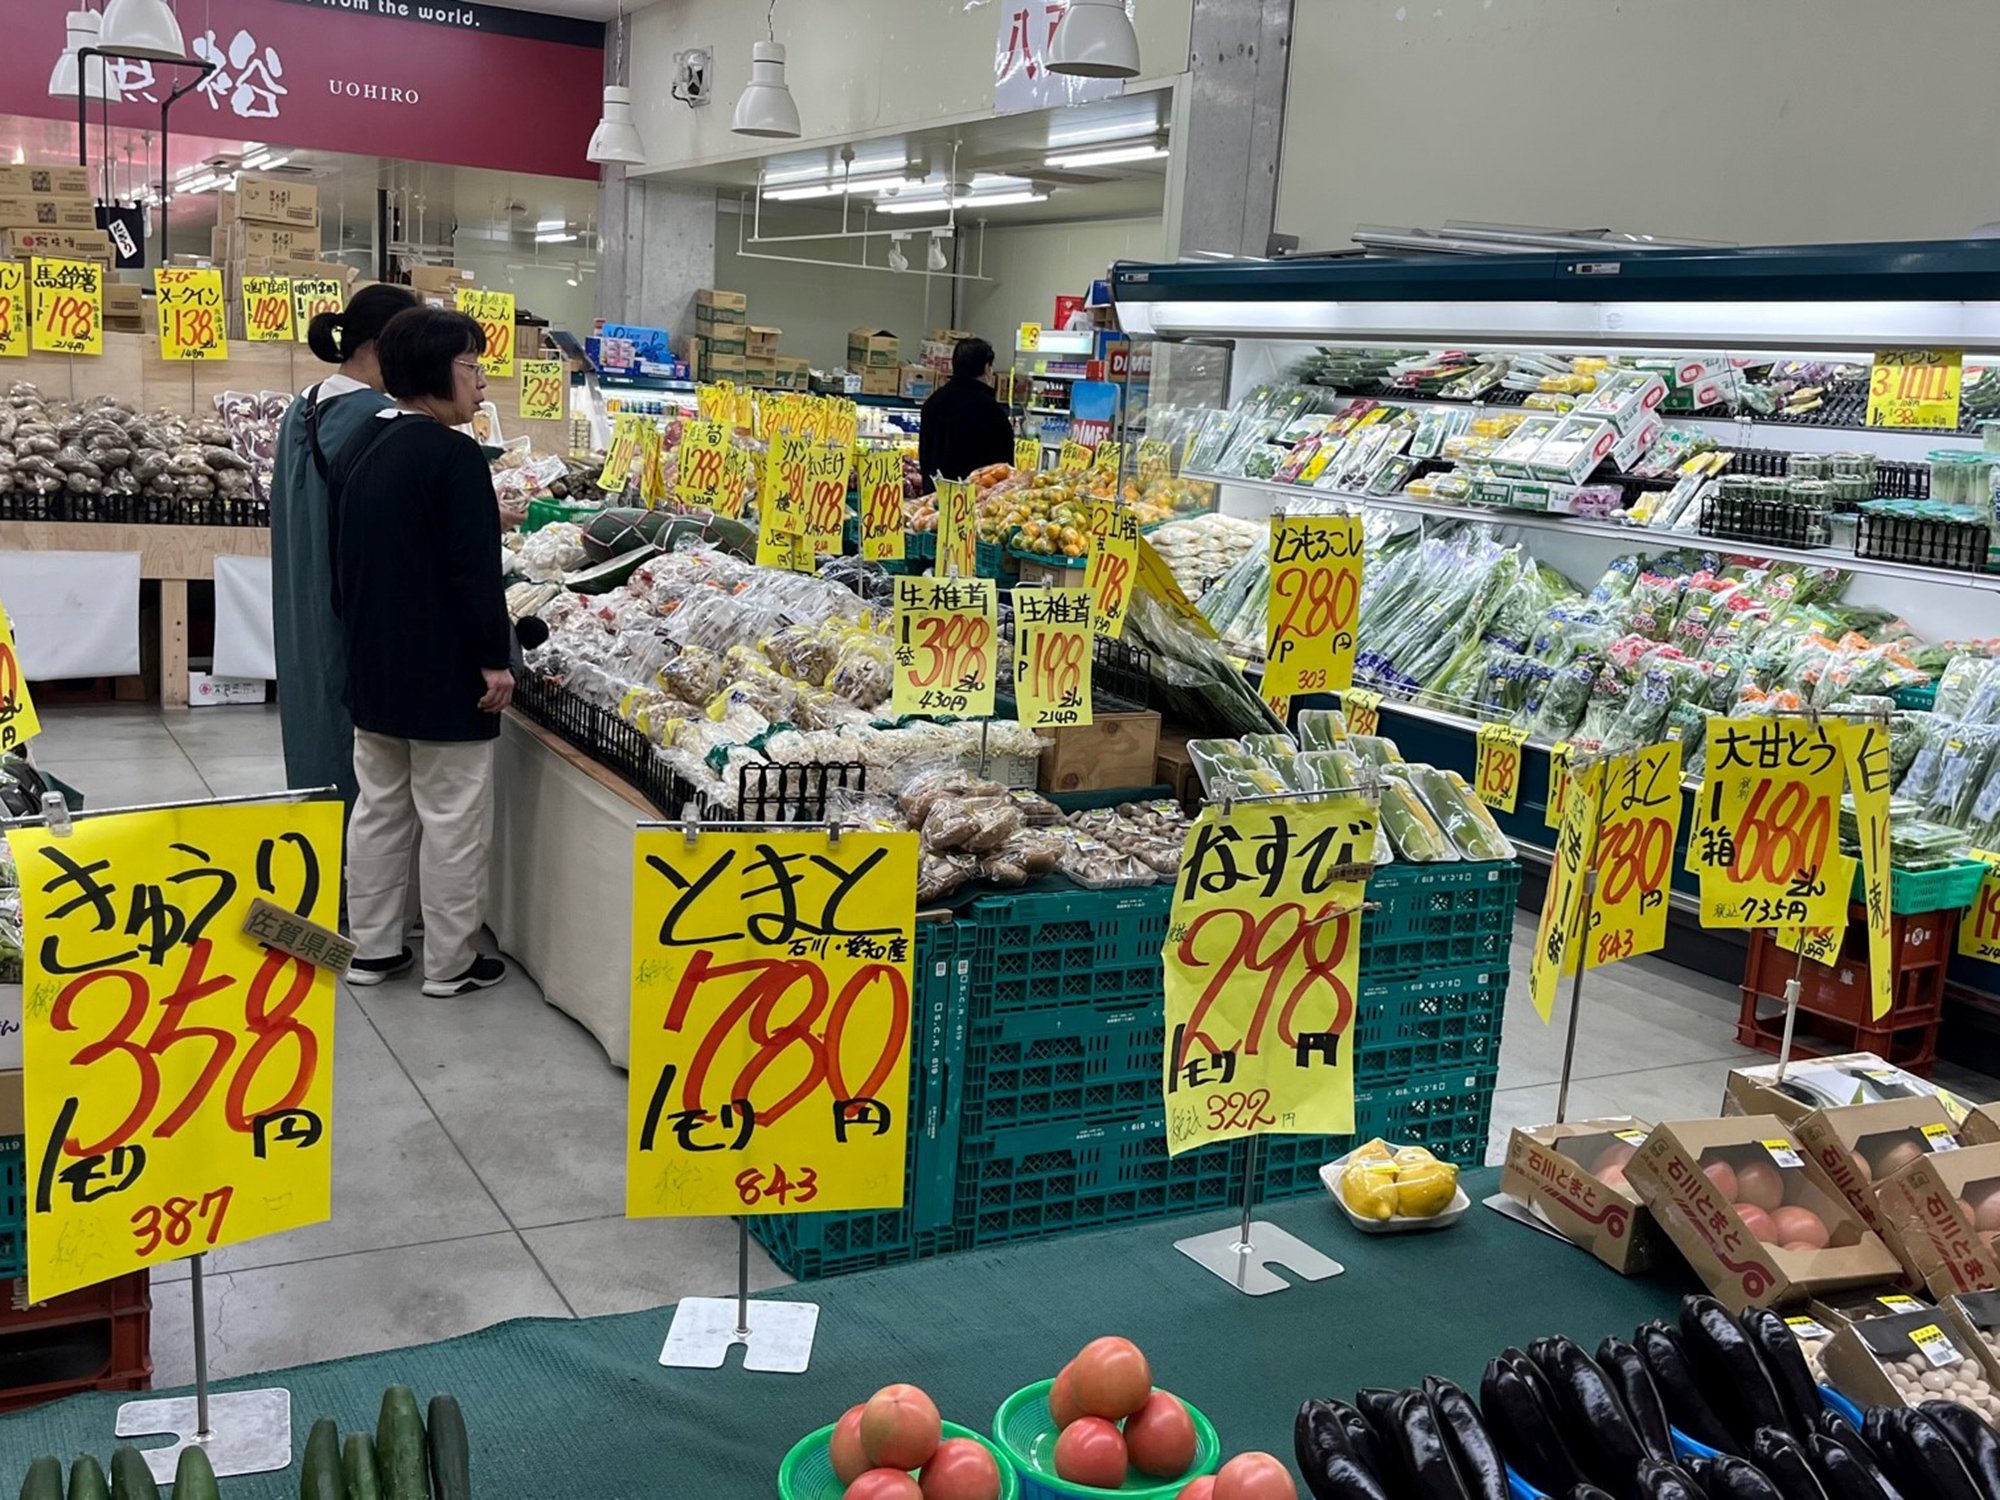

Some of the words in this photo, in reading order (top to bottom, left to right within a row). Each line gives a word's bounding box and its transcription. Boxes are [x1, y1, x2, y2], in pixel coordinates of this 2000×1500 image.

[378, 0, 409, 16] the
[418, 7, 480, 27] world.
[329, 80, 419, 104] UOHIRO
[34, 264, 97, 293] 馬鈴薯
[159, 287, 220, 306] メークイン
[47, 296, 94, 337] 198
[175, 309, 214, 346] 138
[252, 297, 289, 331] 480
[522, 362, 561, 375] 土ごぼう
[527, 377, 561, 408] 258
[687, 449, 723, 490] 298
[808, 480, 844, 534] 198
[868, 483, 902, 533] 198
[1273, 525, 1363, 563] とうもろこし
[901, 580, 988, 616] 生椎茸
[1092, 553, 1129, 612] 178
[1276, 567, 1358, 639] 280
[1019, 592, 1091, 628] 生椎茸
[907, 613, 990, 688] 398
[1332, 632, 1353, 655] 円
[1031, 632, 1086, 703] 198
[1297, 669, 1327, 689] 303
[918, 690, 968, 712] 430円
[1037, 710, 1078, 724] 214円
[1482, 748, 1517, 793] 138
[1715, 722, 1837, 776] 大甘とう
[1727, 778, 1831, 885] 680
[1182, 815, 1373, 902] なすび
[39, 832, 320, 975] きゅうり
[646, 844, 903, 947] とまと
[1740, 897, 1808, 923] 735円
[246, 908, 357, 969] 佐賀県産
[787, 935, 909, 963] 石川・愛知産
[1599, 929, 1634, 963] 843
[1177, 901, 1353, 1070] 298
[50, 938, 319, 1157] 358
[663, 949, 910, 1128] 780
[1168, 1023, 1236, 1094] 1モリ
[1296, 1032, 1339, 1068] 円
[639, 1064, 756, 1152] 1モリ
[832, 1097, 892, 1144] 円
[1206, 1088, 1277, 1132] 322
[35, 1096, 146, 1214] 1モリ
[252, 1108, 323, 1159] 円
[734, 1163, 819, 1207] 843
[1527, 1150, 1597, 1208] 石川とまと
[131, 1186, 233, 1257] 387
[1667, 1156, 1742, 1253] 石川とまと
